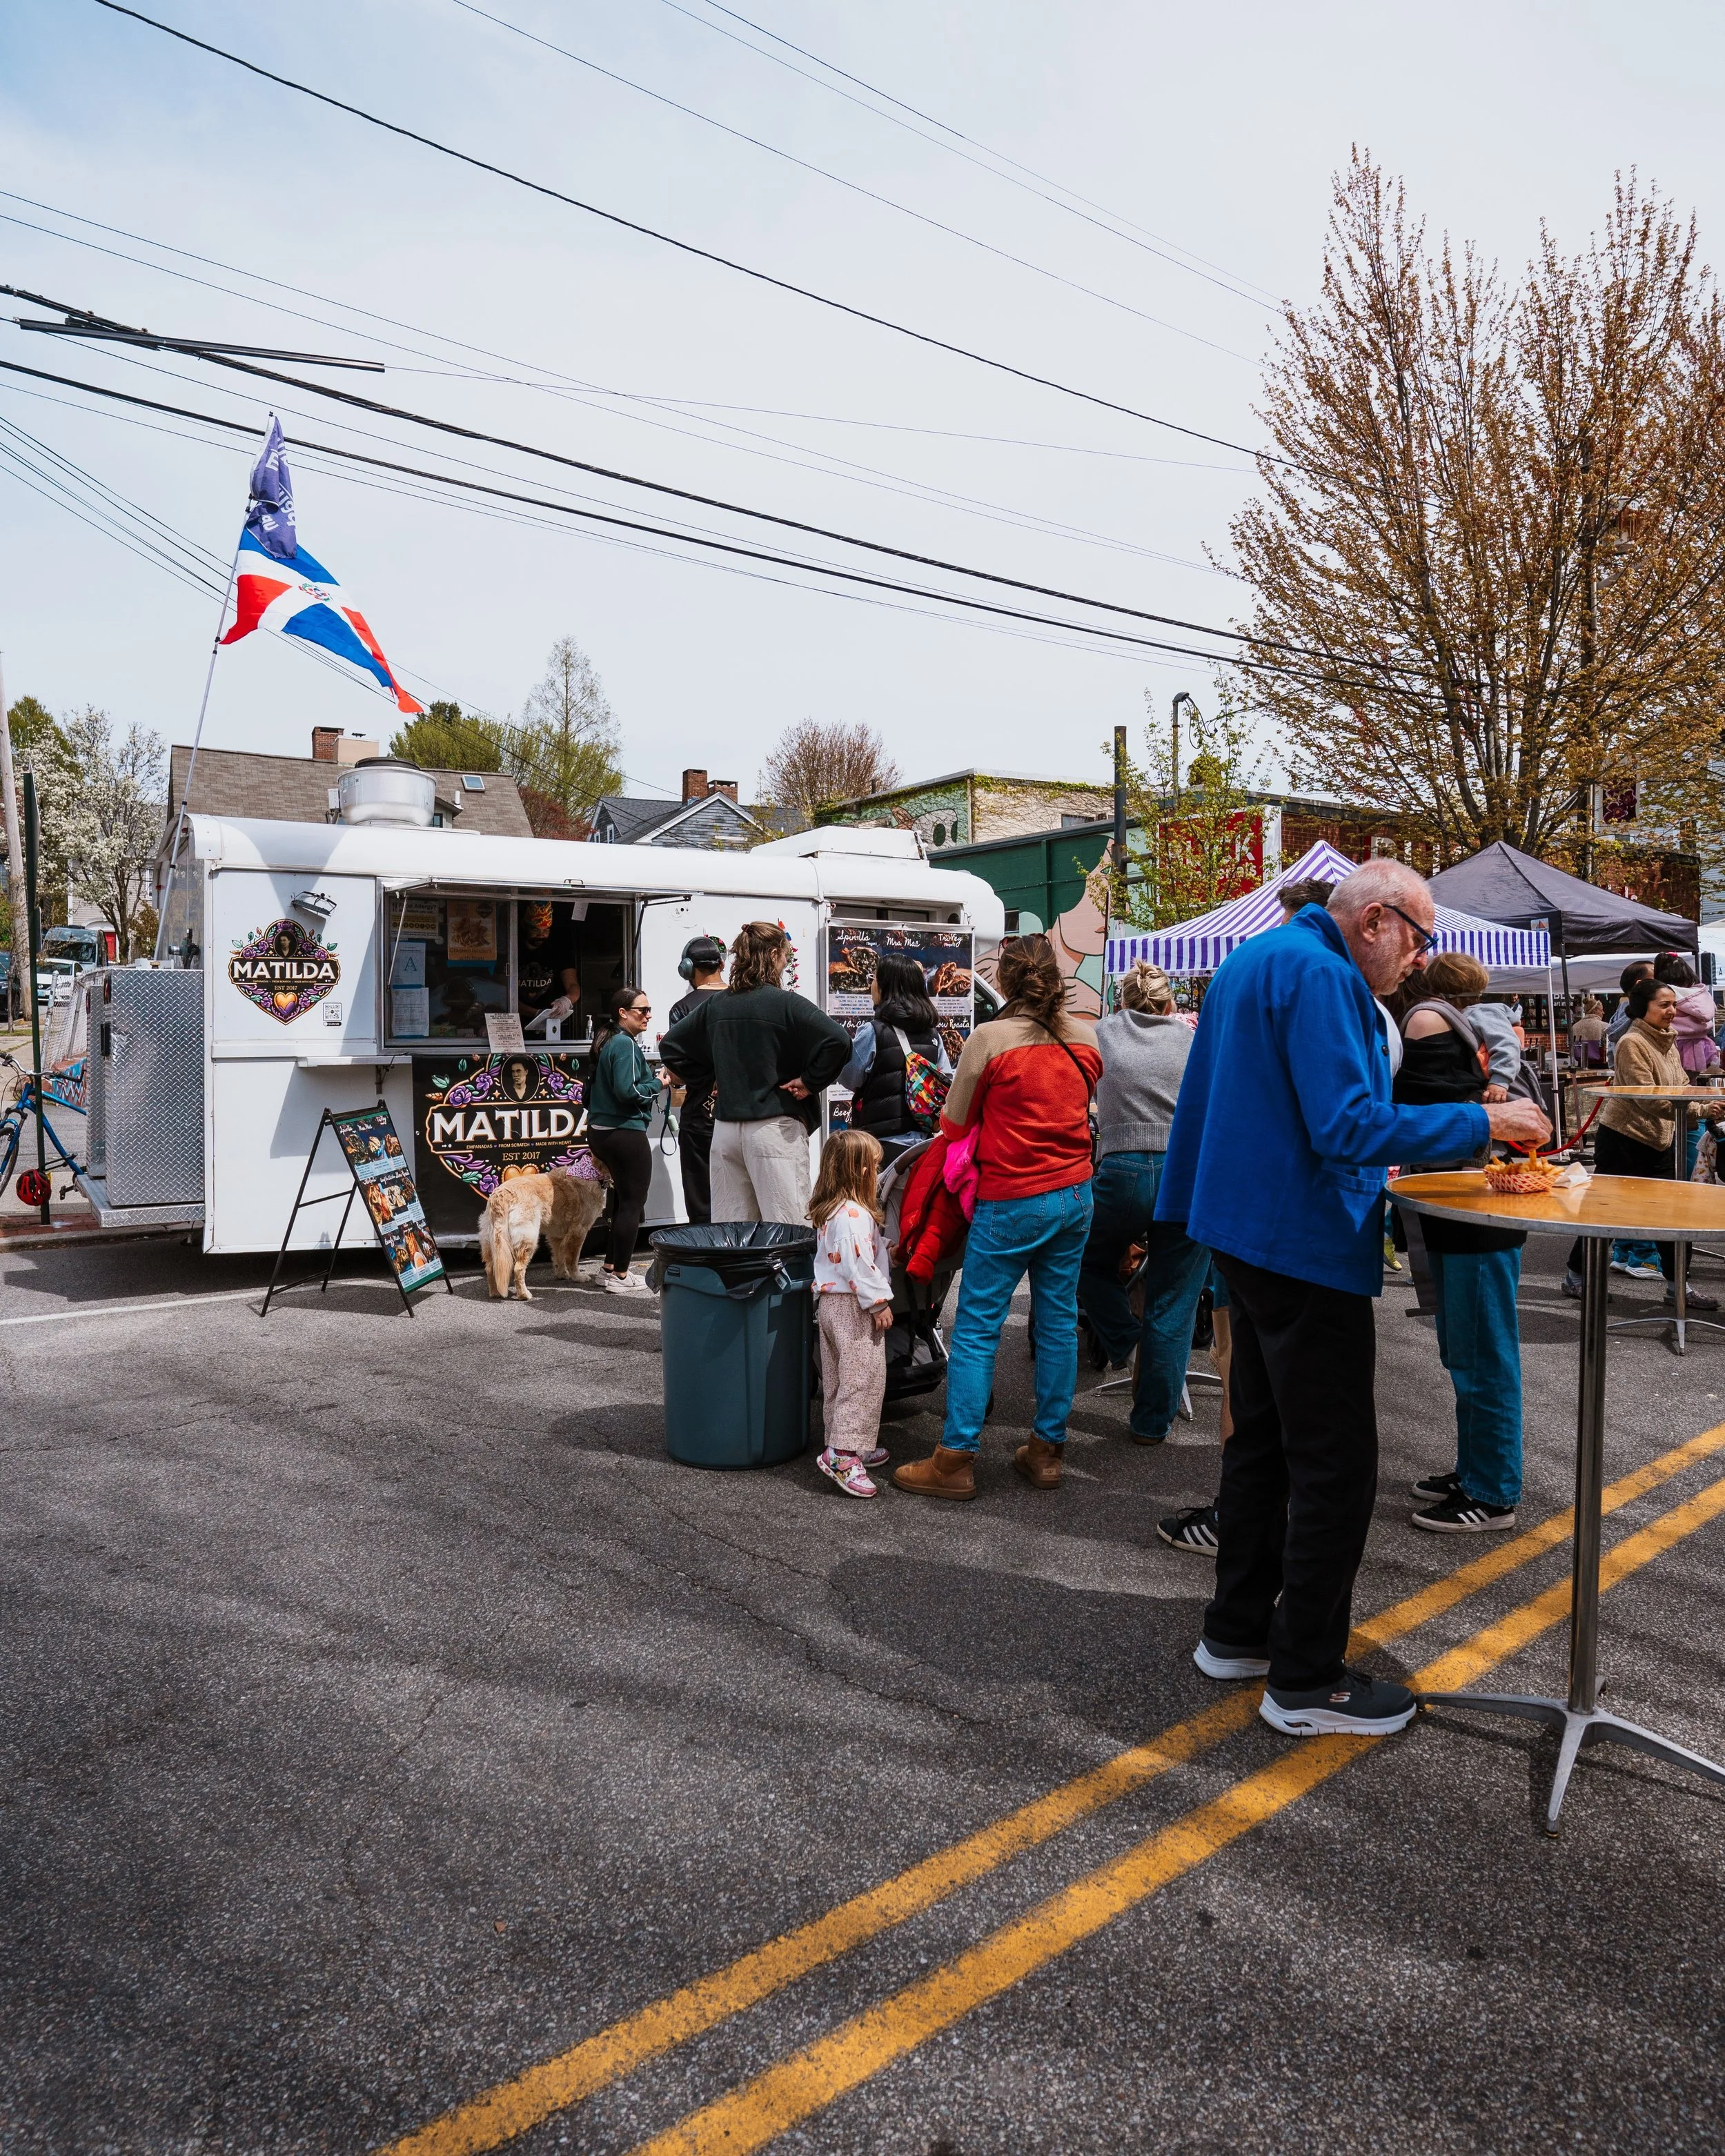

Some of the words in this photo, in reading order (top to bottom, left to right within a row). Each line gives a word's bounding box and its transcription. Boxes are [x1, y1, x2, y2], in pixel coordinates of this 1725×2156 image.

[904, 936, 921, 947] Mac
[404, 956, 417, 971] A
[233, 960, 335, 979] MATILDA
[518, 978, 552, 987] ATILDA
[502, 1153, 520, 1161] EST
[522, 1151, 540, 1160] 2017
